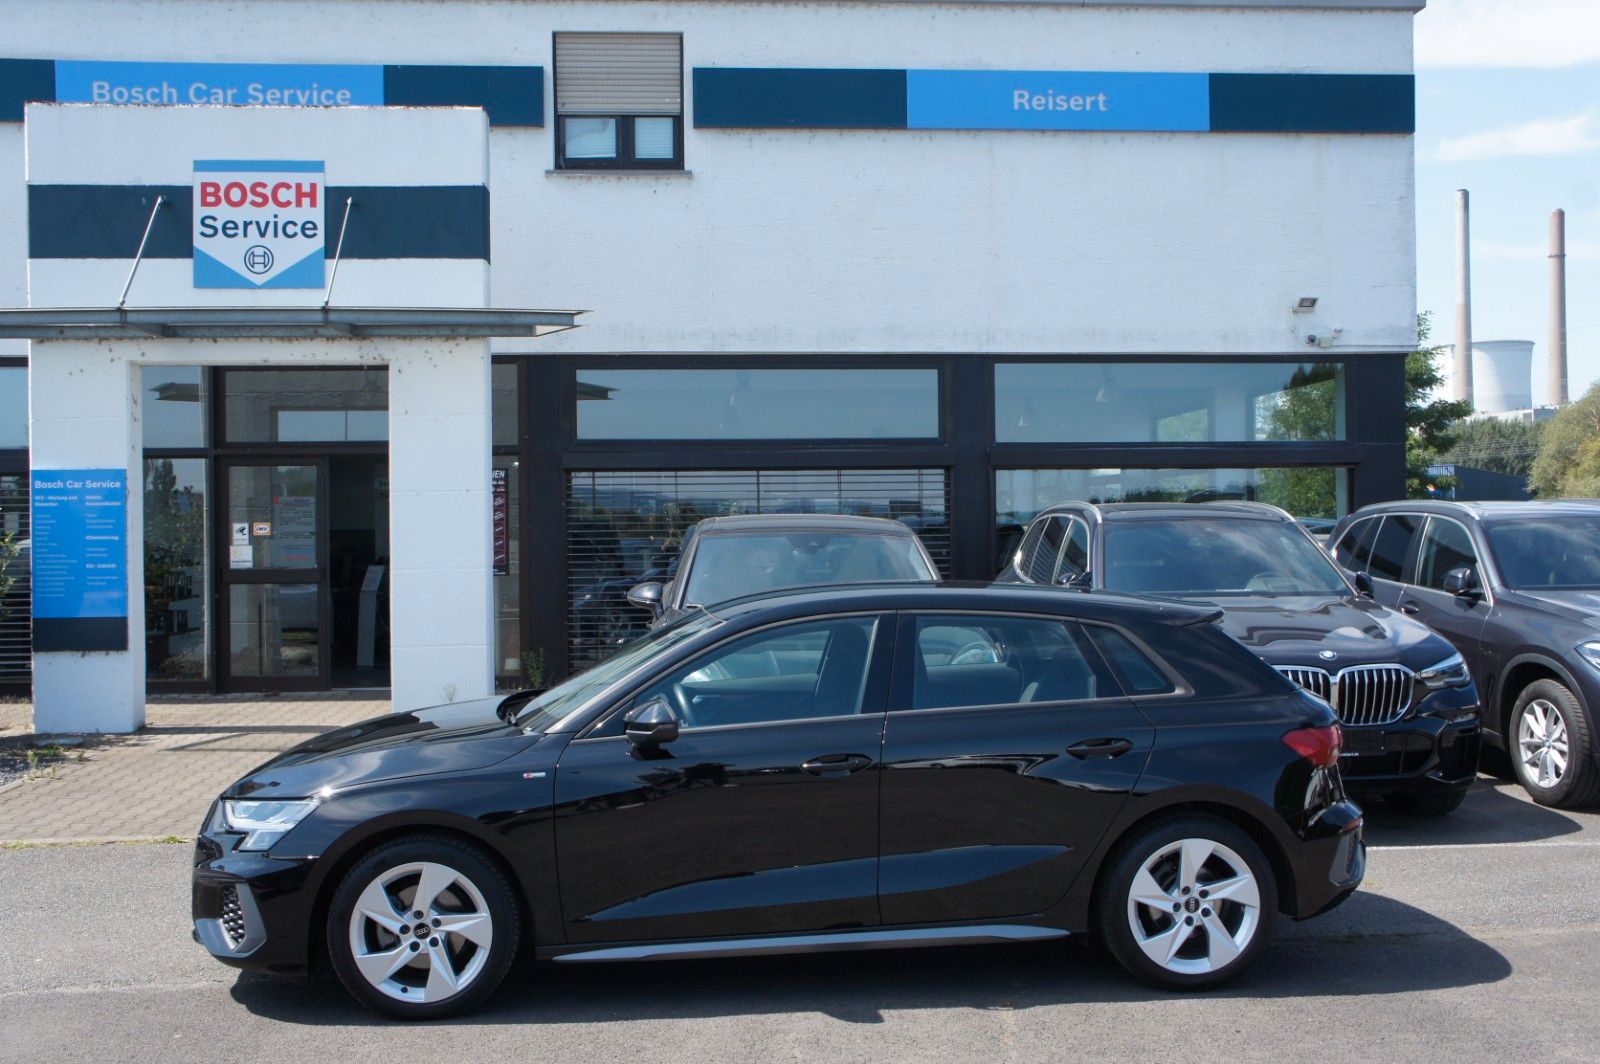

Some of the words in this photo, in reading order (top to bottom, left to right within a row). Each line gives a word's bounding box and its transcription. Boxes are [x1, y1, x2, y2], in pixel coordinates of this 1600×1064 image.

[91, 80, 178, 104] Bosch
[188, 82, 238, 105] Car
[246, 83, 351, 106] Service
[1013, 89, 1108, 112] Reisert
[200, 181, 318, 209] BOSCH
[199, 213, 319, 239] Service
[34, 479, 64, 489] Bosch
[66, 480, 83, 488] Car
[85, 479, 121, 488] Service
